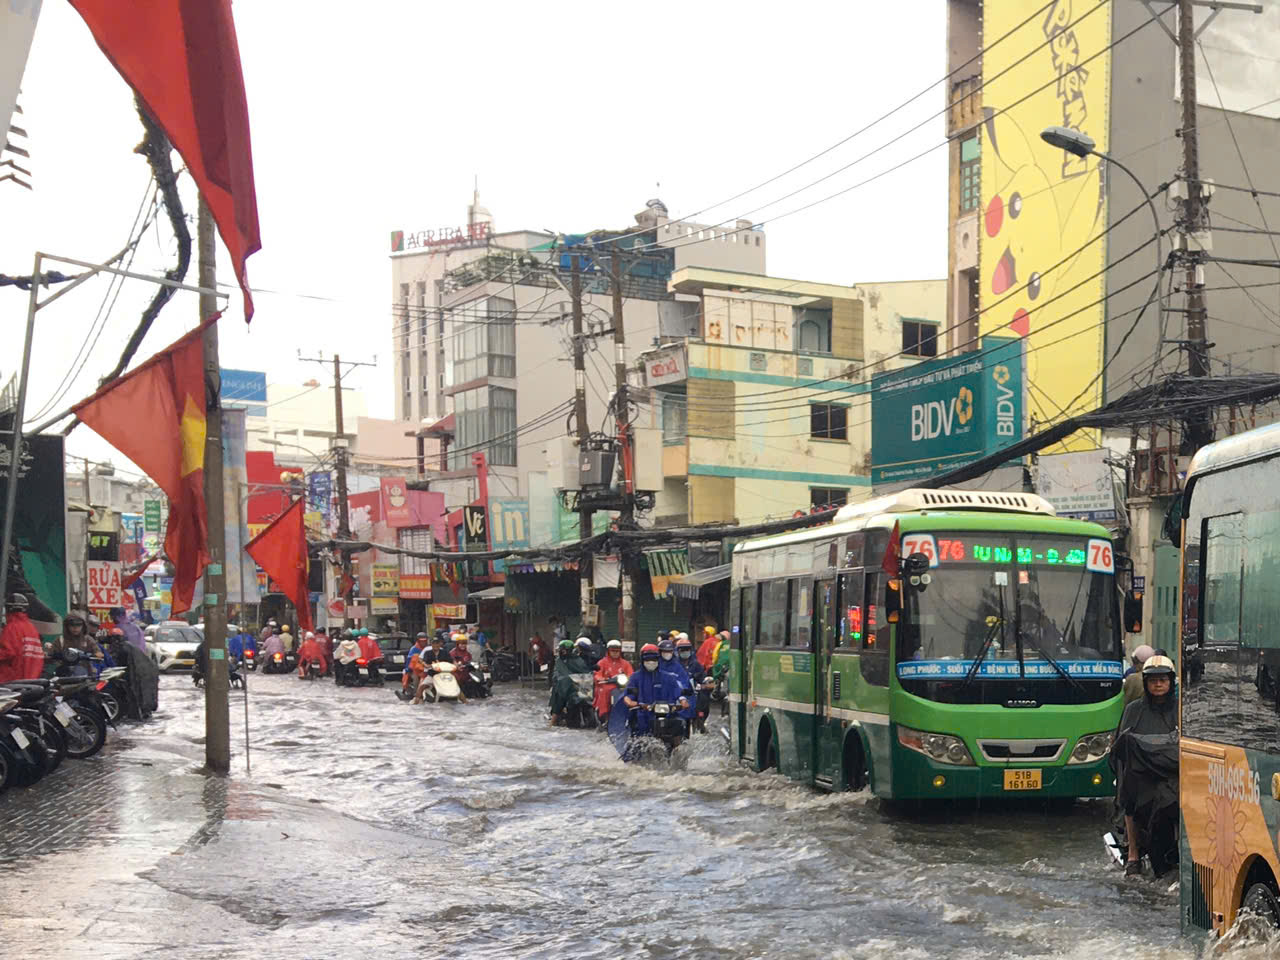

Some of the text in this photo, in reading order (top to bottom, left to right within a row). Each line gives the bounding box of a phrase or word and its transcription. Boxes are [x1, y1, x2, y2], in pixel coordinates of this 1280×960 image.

[912, 397, 957, 441] BIDV
[996, 384, 1014, 436] BIDV
[905, 540, 934, 561] 76
[938, 540, 965, 560] 76
[1090, 545, 1112, 567] 76
[88, 561, 121, 587] RỬA
[90, 588, 119, 605] XE
[900, 666, 916, 675] LONG
[1008, 664, 1022, 674] VIỆ
[1083, 665, 1091, 673] XE
[1015, 771, 1032, 779] 51B
